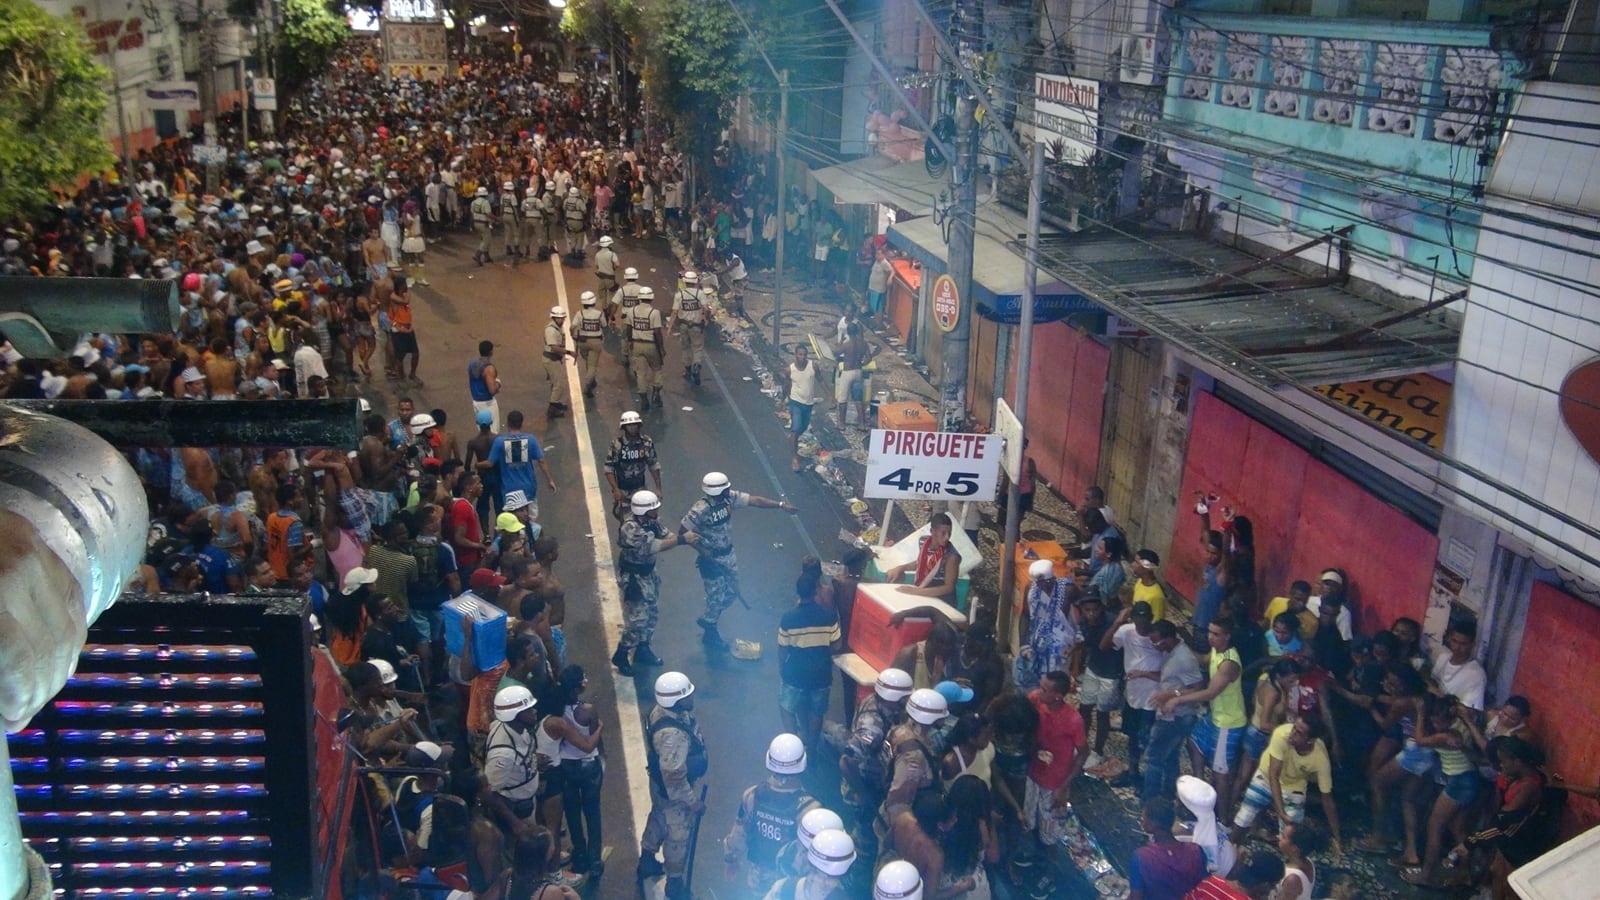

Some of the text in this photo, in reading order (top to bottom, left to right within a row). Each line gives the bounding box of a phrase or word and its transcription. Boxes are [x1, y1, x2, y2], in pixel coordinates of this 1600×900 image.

[1359, 377, 1440, 418] da
[1312, 383, 1438, 449] tima
[621, 449, 639, 460] 2108
[882, 430, 986, 459] PIRIGUETE
[878, 467, 979, 497] 4 POR 5
[756, 820, 782, 841] 1986
